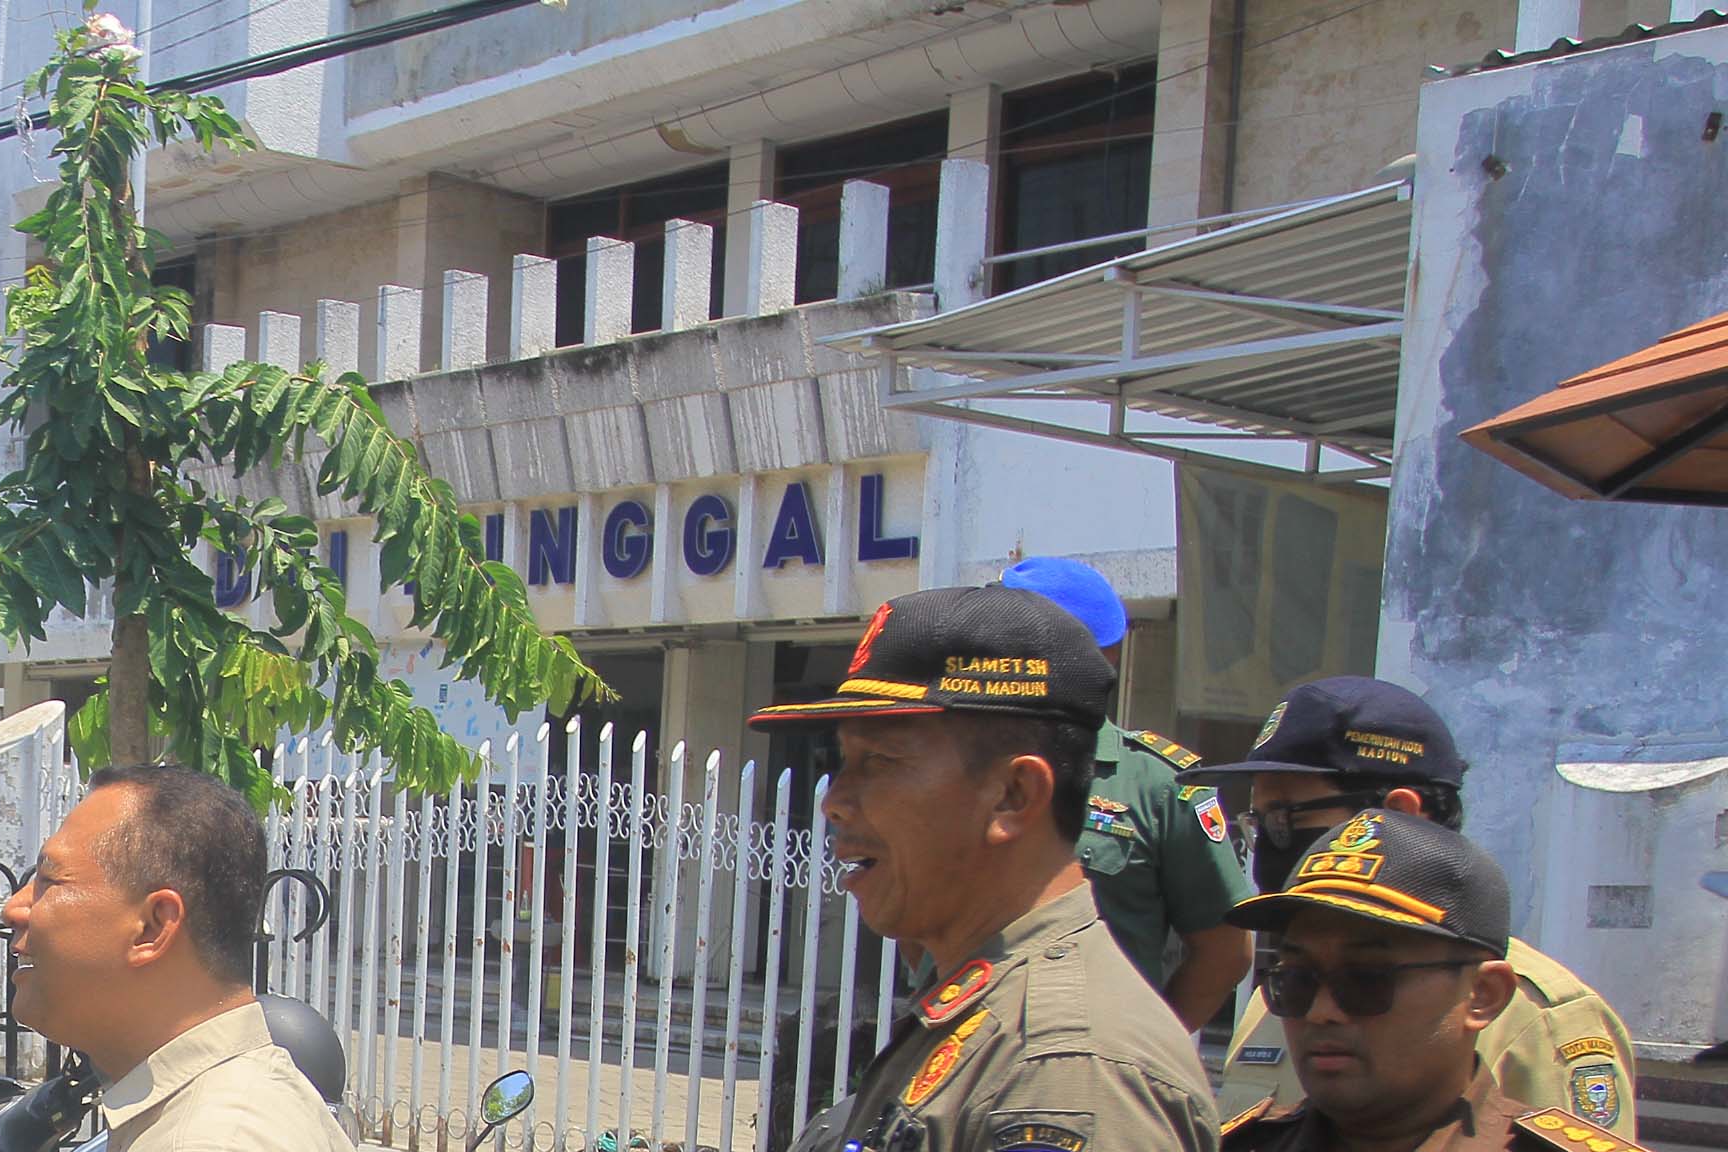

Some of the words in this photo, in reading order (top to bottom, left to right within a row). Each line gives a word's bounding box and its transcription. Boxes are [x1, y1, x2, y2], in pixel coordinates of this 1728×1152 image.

[400, 473, 919, 596] NGGAL
[945, 656, 1023, 673] SLAMET
[939, 677, 981, 694] KOTA
[985, 681, 1048, 697] MADIUN
